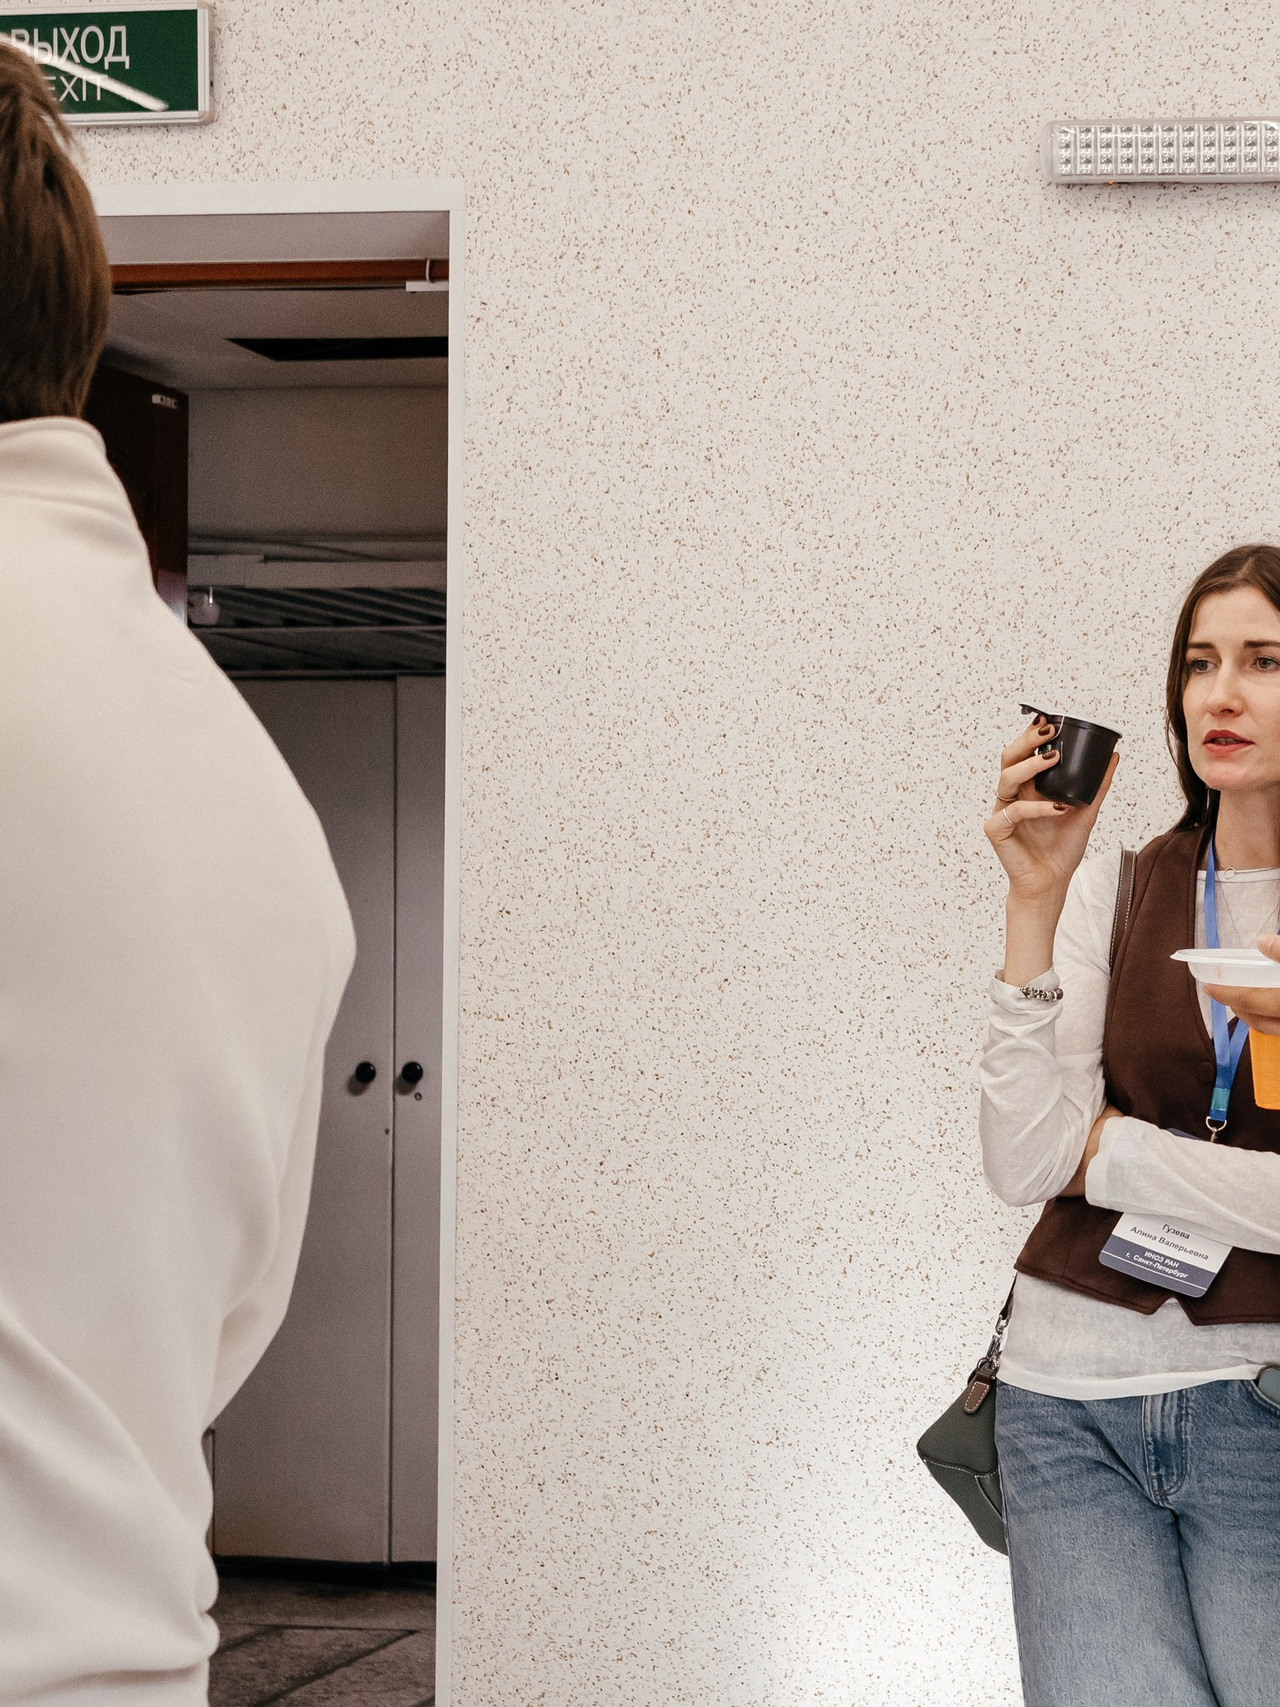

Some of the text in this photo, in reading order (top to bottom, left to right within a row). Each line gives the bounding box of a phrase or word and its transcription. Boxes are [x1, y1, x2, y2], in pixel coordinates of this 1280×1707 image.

[1161, 1224, 1190, 1239] Гузева
[1130, 1227, 1209, 1261] Алина Валерьевна
[1133, 1255, 1188, 1278] Санкт-Петербург
[1164, 1259, 1180, 1268] РАН
